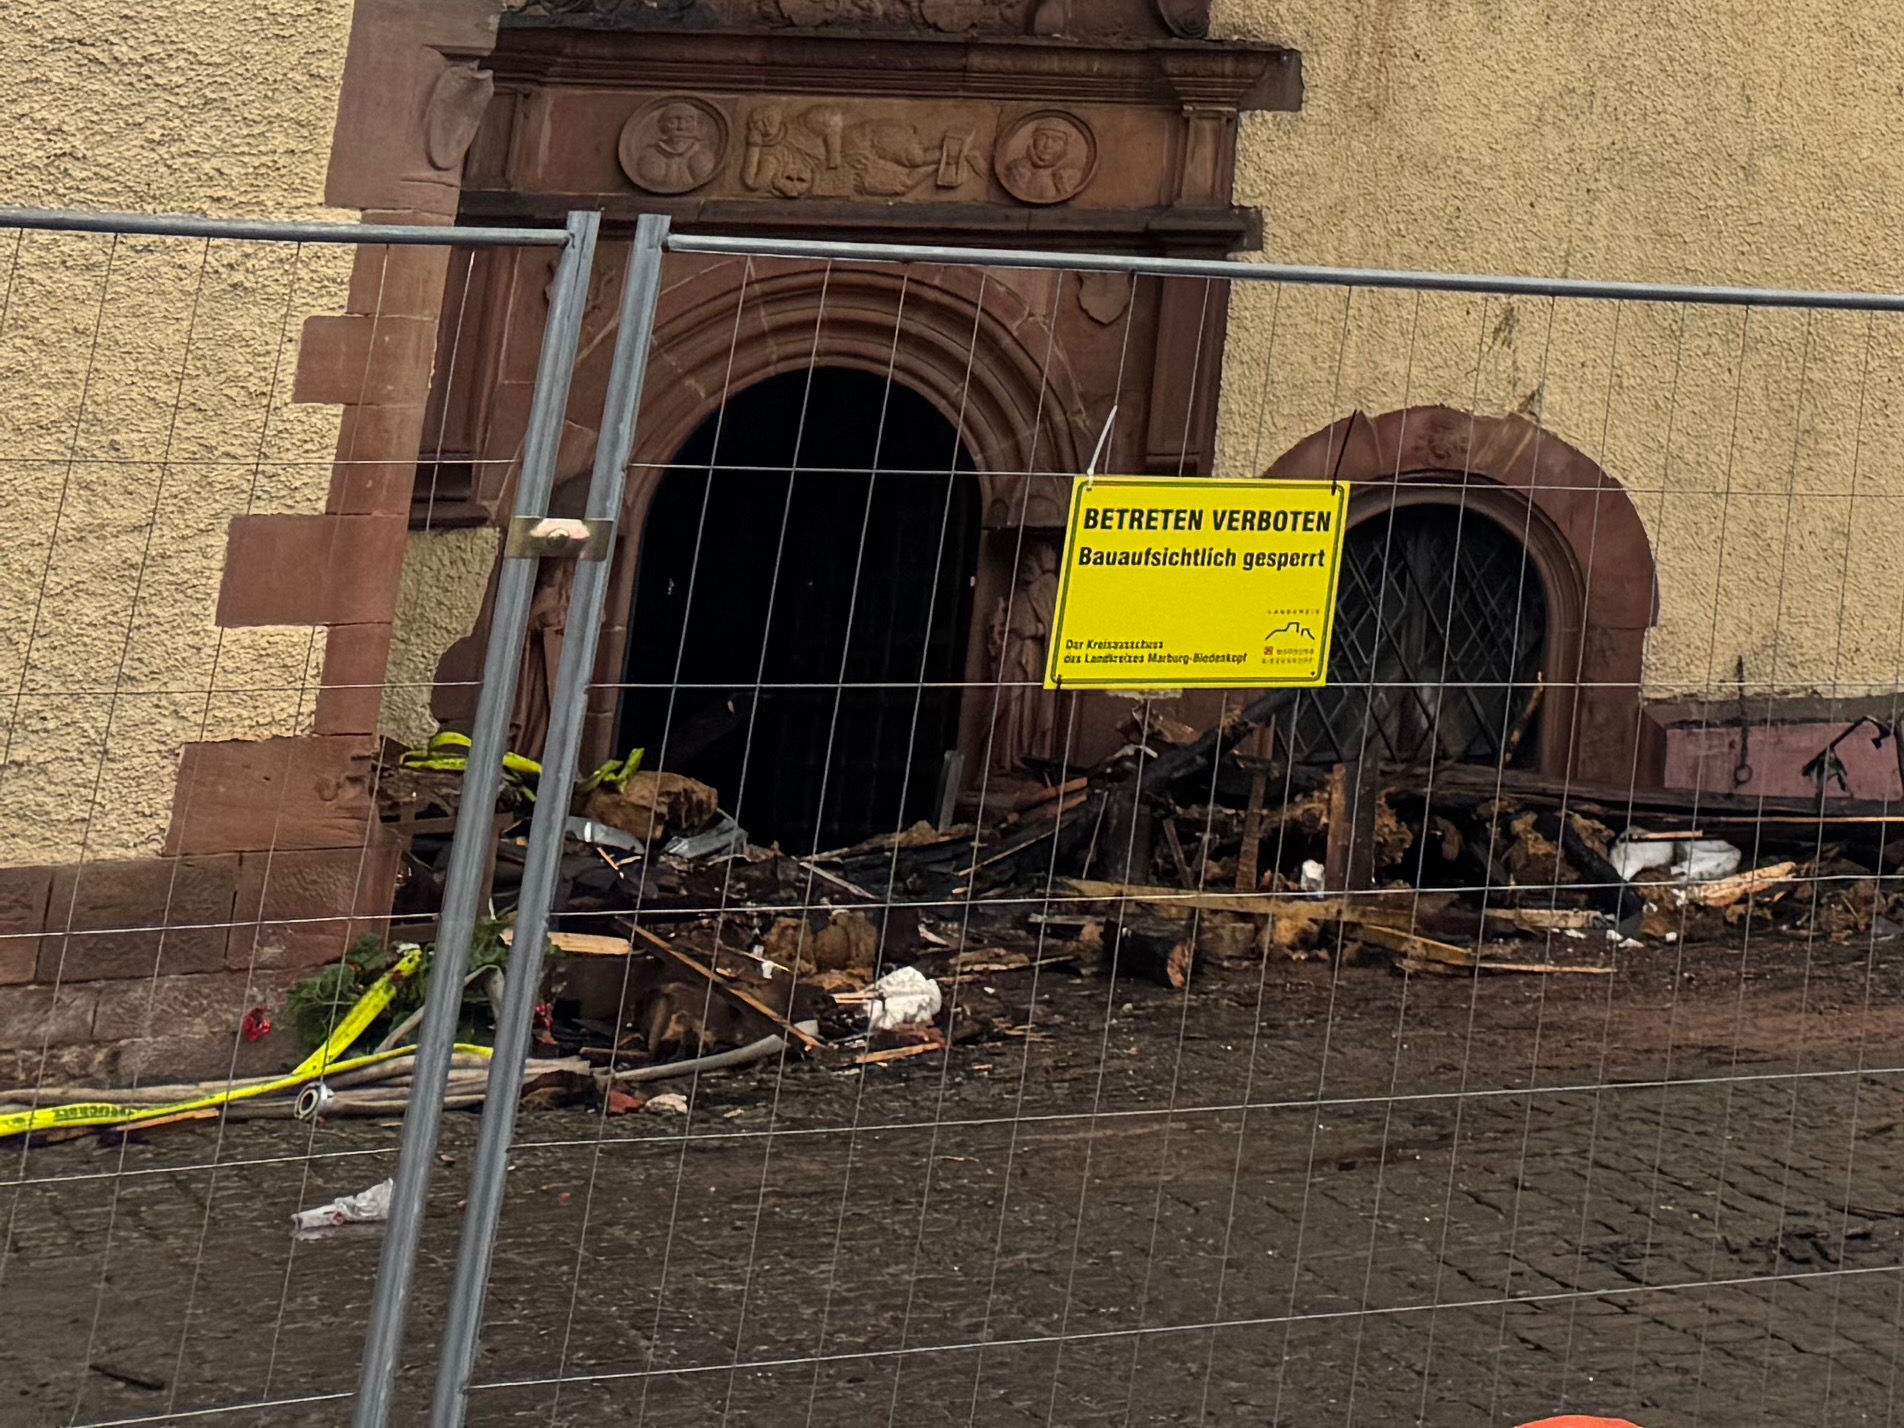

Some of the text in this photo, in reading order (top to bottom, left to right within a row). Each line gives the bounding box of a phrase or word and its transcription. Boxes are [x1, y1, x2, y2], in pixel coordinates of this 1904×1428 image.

[1083, 508, 1332, 532] BETRETEN VERBOTEN
[1078, 546, 1326, 572] Bauaufsichtlich gesperrt
